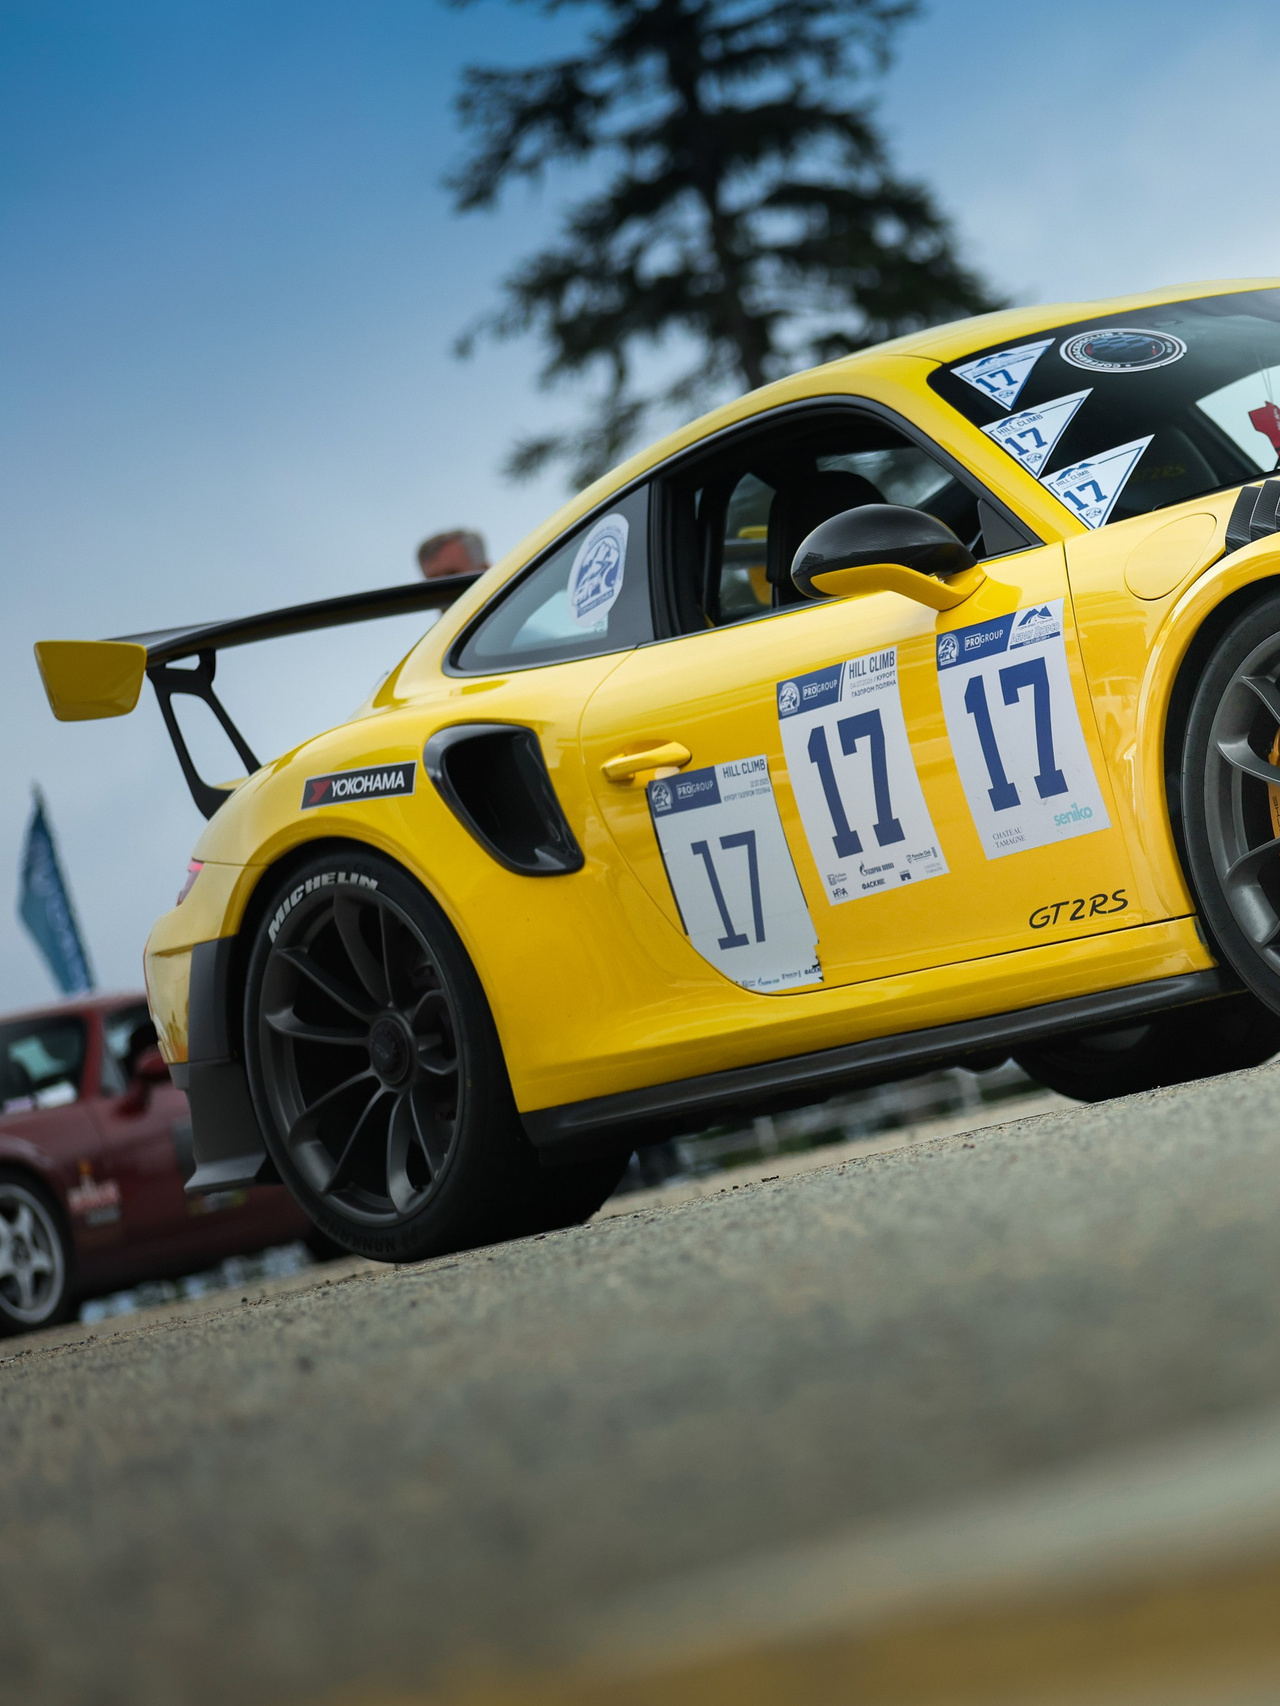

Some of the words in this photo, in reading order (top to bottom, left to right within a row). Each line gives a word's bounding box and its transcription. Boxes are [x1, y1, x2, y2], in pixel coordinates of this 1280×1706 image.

[975, 369, 1018, 393] 17
[996, 424, 1017, 435] HILL
[1016, 413, 1044, 427] CLIMB
[1004, 427, 1048, 456] 17
[1056, 478, 1070, 487] HILL
[1070, 469, 1090, 481] CLIMB
[1063, 479, 1108, 511] 17
[965, 629, 1003, 650] PROGROUP
[849, 659, 867, 679] HILL
[869, 651, 895, 673] CLIMB
[803, 679, 837, 698] PROGROUP
[963, 656, 1069, 812] 17
[722, 765, 741, 778] HILL
[741, 759, 766, 775] CLIMB
[331, 770, 405, 798] YOKOHAMA
[677, 780, 713, 798] PROGROUP
[807, 709, 905, 858] 17
[1053, 802, 1093, 827] seniko
[992, 827, 1022, 841] CHATEAU
[995, 834, 1026, 848] TAMAGNE
[691, 830, 766, 950] 17
[268, 871, 379, 943] MICHELIN
